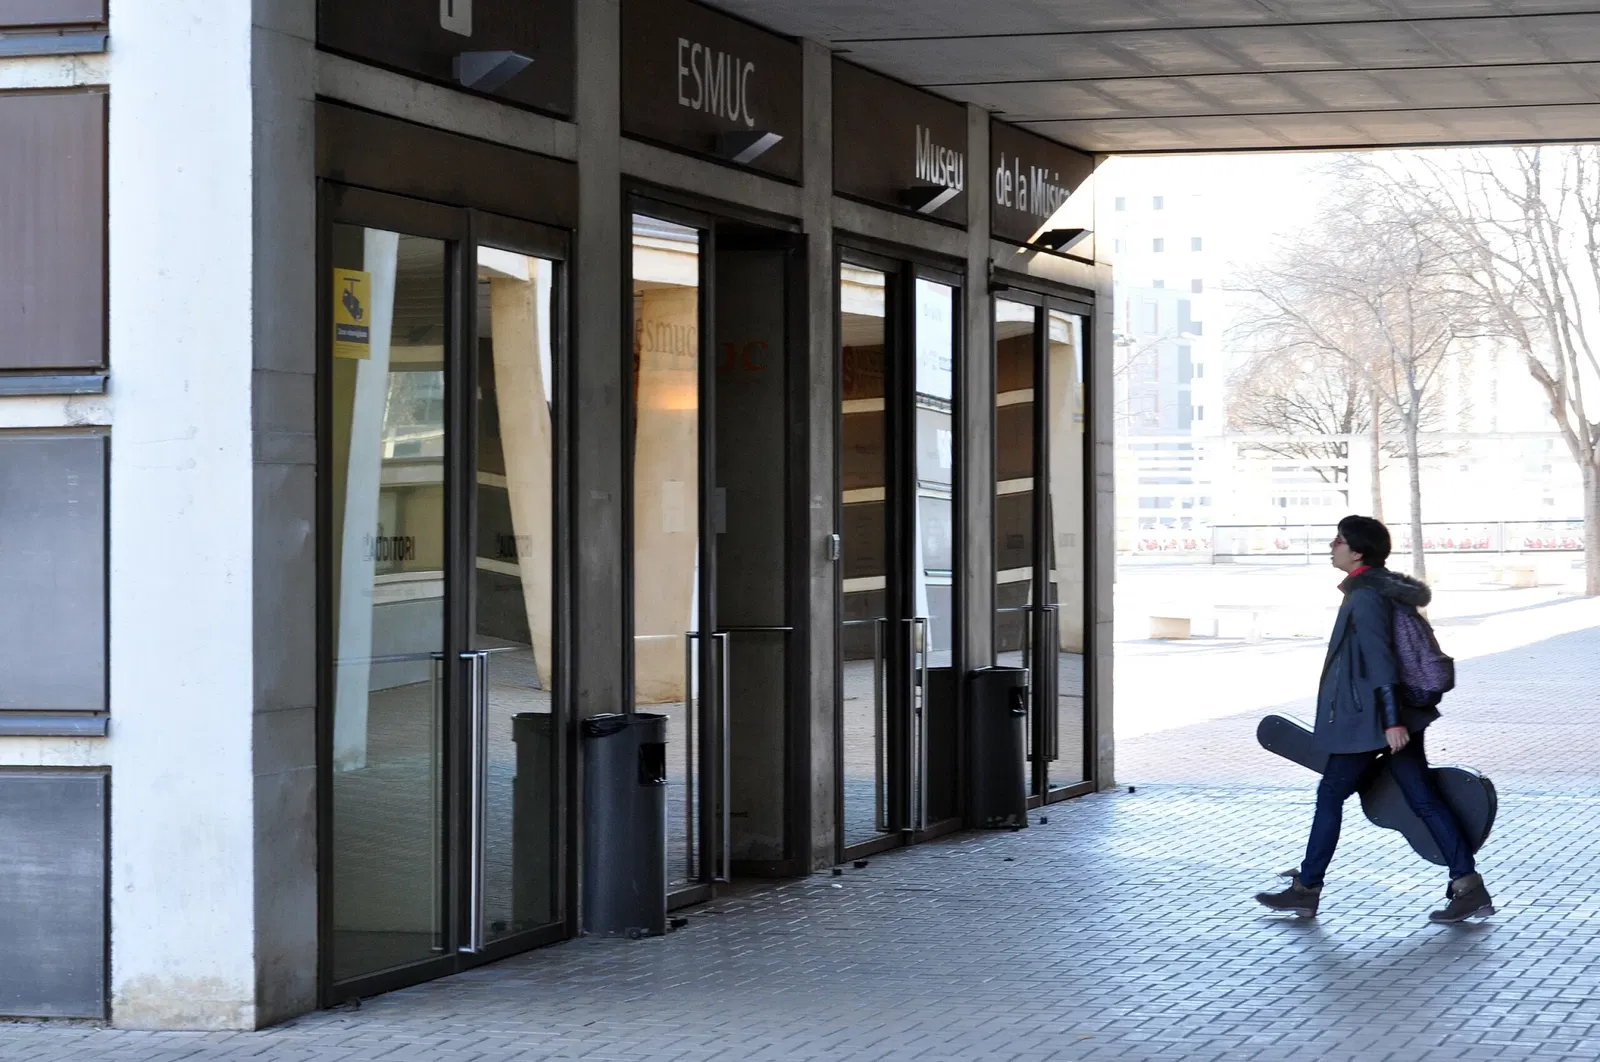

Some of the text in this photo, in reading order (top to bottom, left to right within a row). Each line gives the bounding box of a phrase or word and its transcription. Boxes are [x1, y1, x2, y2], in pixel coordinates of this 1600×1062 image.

[678, 37, 755, 127] ESMUC
[915, 125, 1070, 219] Museu de la Músic
